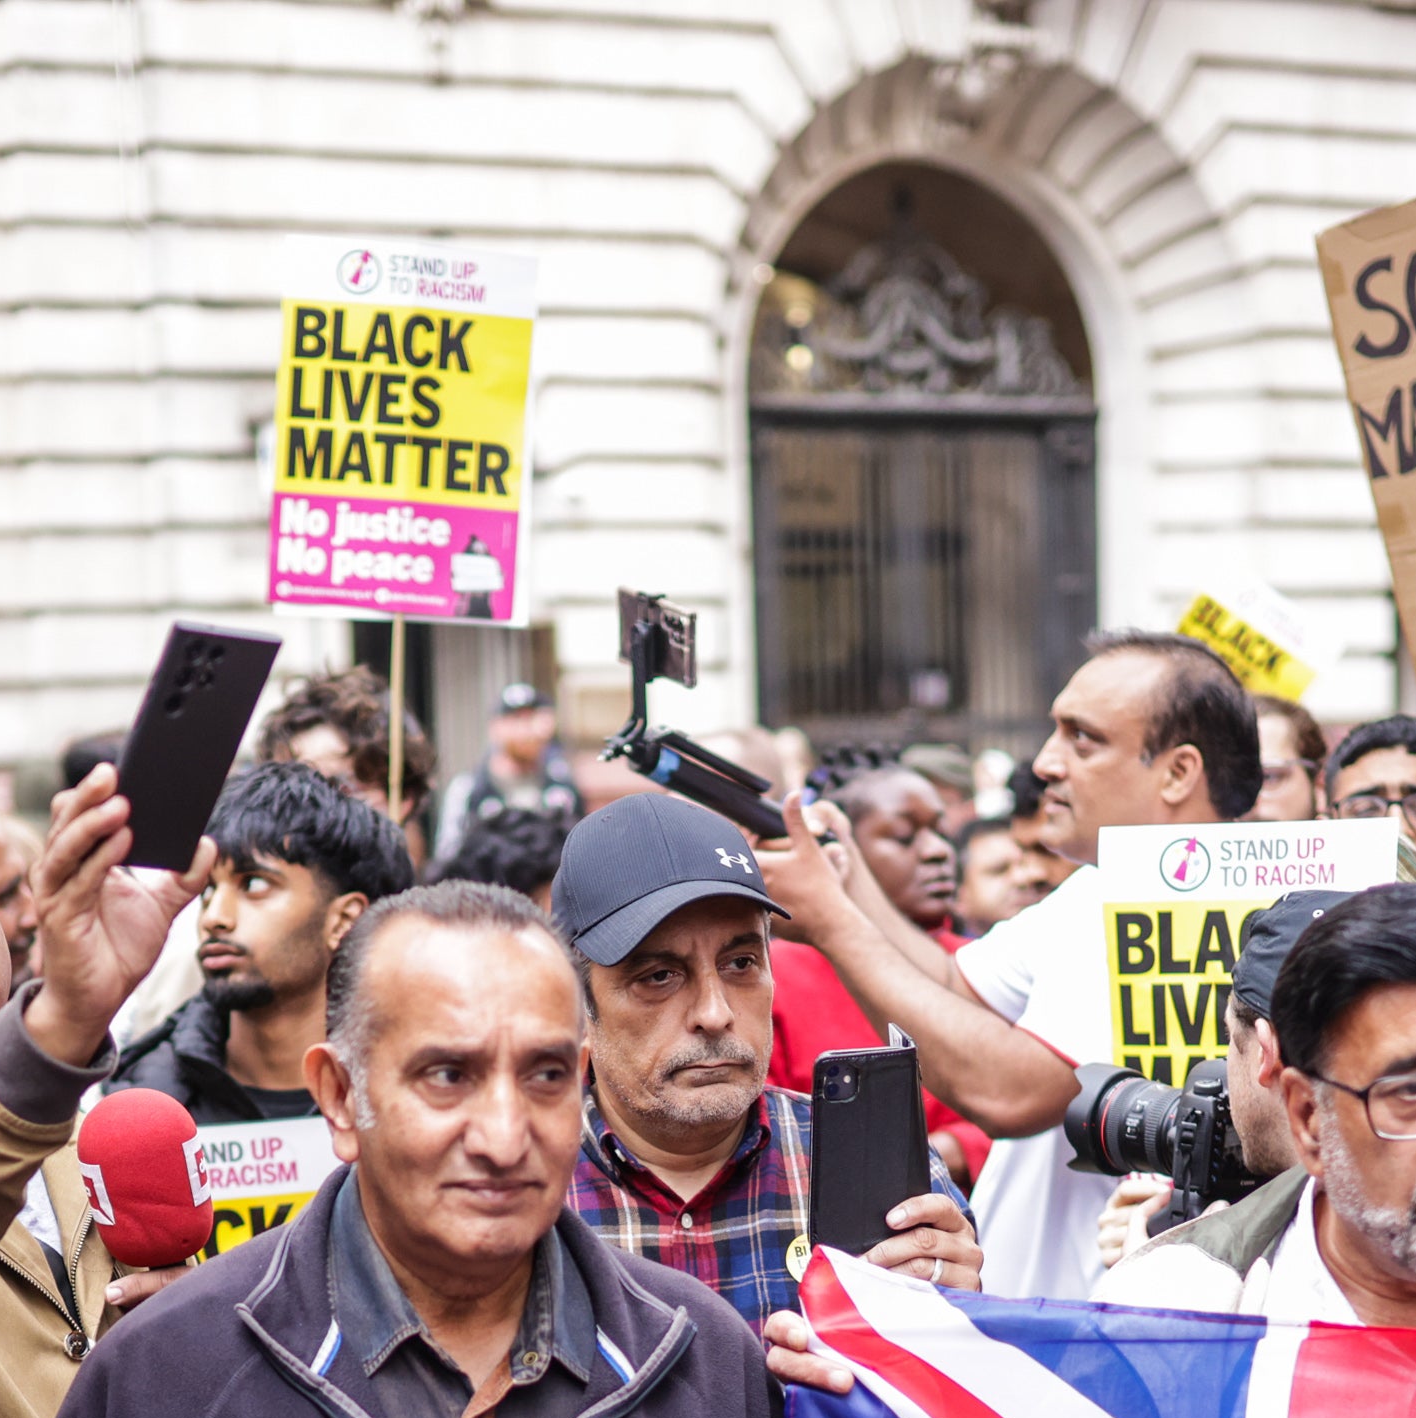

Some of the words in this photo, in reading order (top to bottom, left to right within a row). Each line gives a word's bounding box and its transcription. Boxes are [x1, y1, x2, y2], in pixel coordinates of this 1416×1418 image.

[389, 255, 446, 277] STAND
[451, 261, 478, 279] UP
[389, 276, 413, 295] TO
[416, 279, 487, 303] RACISM
[294, 307, 474, 373] BLACK
[291, 366, 441, 428] LIVES
[287, 426, 510, 496] MATTER
[280, 498, 329, 536] No
[331, 501, 451, 546] justice
[276, 536, 327, 575] No
[331, 548, 435, 585] peace
[1220, 839, 1289, 862] STAND
[1296, 838, 1325, 860] UP
[1220, 866, 1247, 887] TO
[1255, 864, 1335, 886] RACISM
[251, 1137, 283, 1160] UP
[209, 1162, 298, 1189] RACISM
